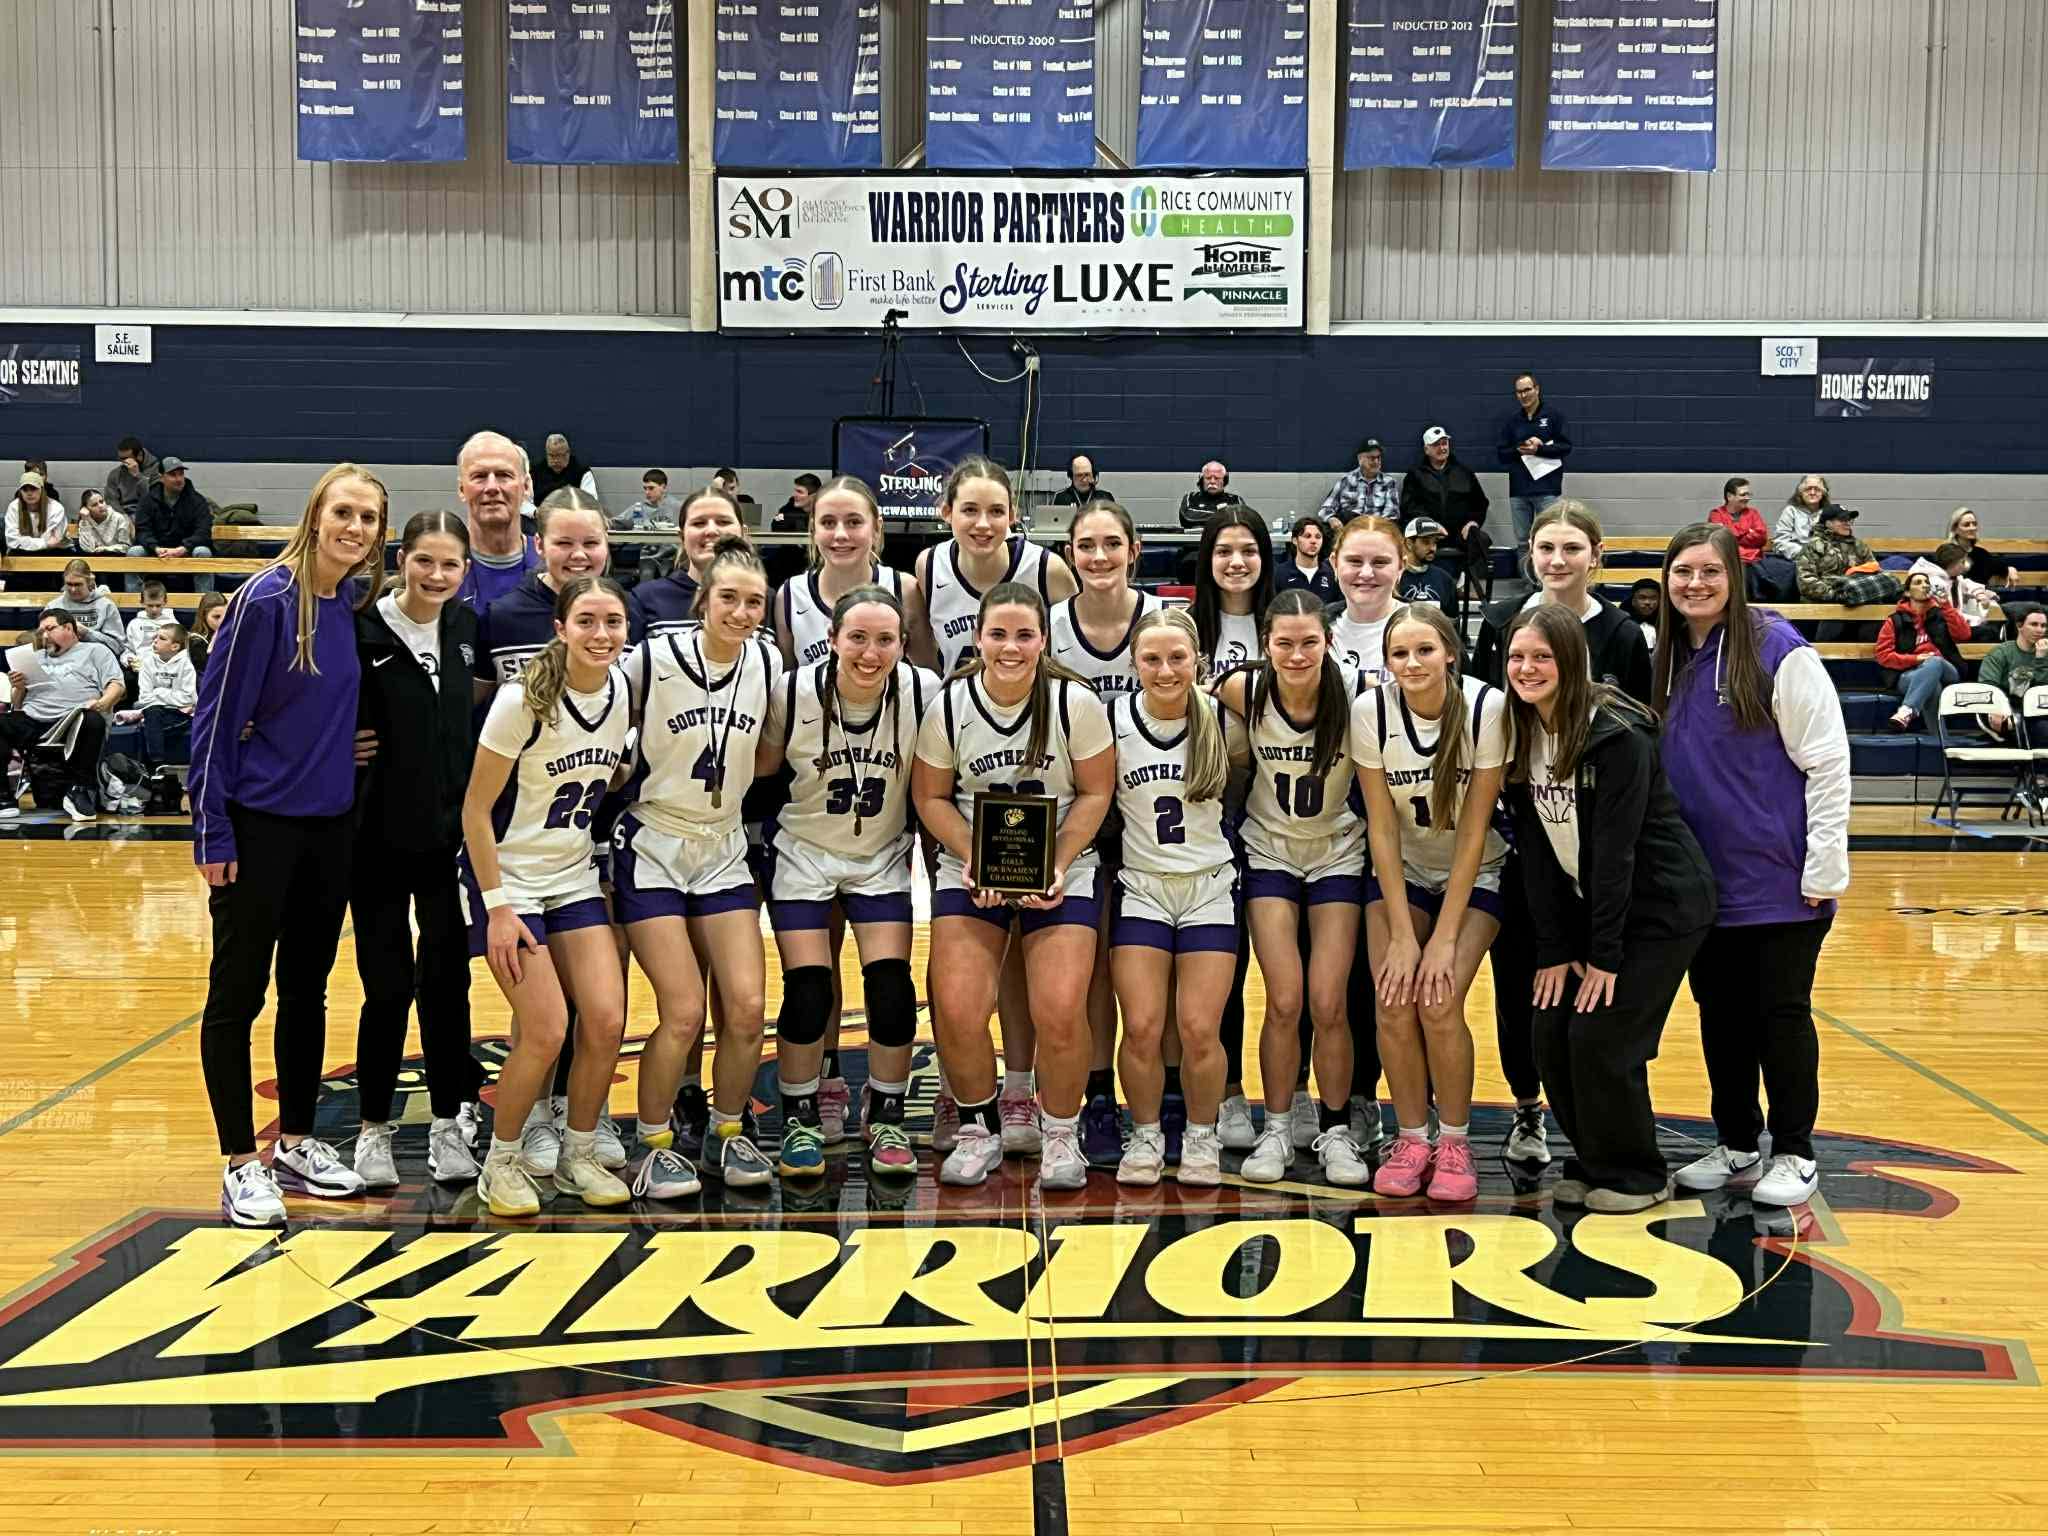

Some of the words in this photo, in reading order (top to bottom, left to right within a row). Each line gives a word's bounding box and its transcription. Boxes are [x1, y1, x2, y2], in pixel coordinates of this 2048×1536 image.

[1393, 21, 1447, 30] INDUCTED
[1452, 22, 1472, 30] 2012
[971, 36, 1024, 45] INDUCTED
[1028, 37, 1054, 45] 2000
[1161, 191, 1191, 210] RICE
[1197, 191, 1292, 210] COMMUNITY
[868, 191, 984, 243] WARRIOR
[993, 192, 1125, 244] PARTNERS
[1181, 219, 1273, 234] HEALTH
[1204, 244, 1271, 262] HOME
[1204, 264, 1271, 272] LUMBER
[723, 266, 804, 301] mtc
[849, 270, 886, 291] First
[893, 270, 935, 291] Bank
[940, 262, 1048, 315] Sterling
[1053, 263, 1173, 302] LUXE
[1222, 291, 1282, 300] PINNACLE
[116, 333, 131, 343] S.E.
[108, 344, 139, 355] SALINE
[22, 360, 79, 385] SEATING
[1780, 358, 1800, 368] CITY
[1821, 374, 1863, 399] HOME
[1867, 374, 1930, 400] SEATING
[880, 474, 942, 493] STERLING
[690, 743, 726, 792] 4
[826, 777, 886, 817] 33
[1274, 772, 1324, 818] 10
[1154, 796, 1185, 844] 2
[0, 1201, 1745, 1368] WARRIORS
